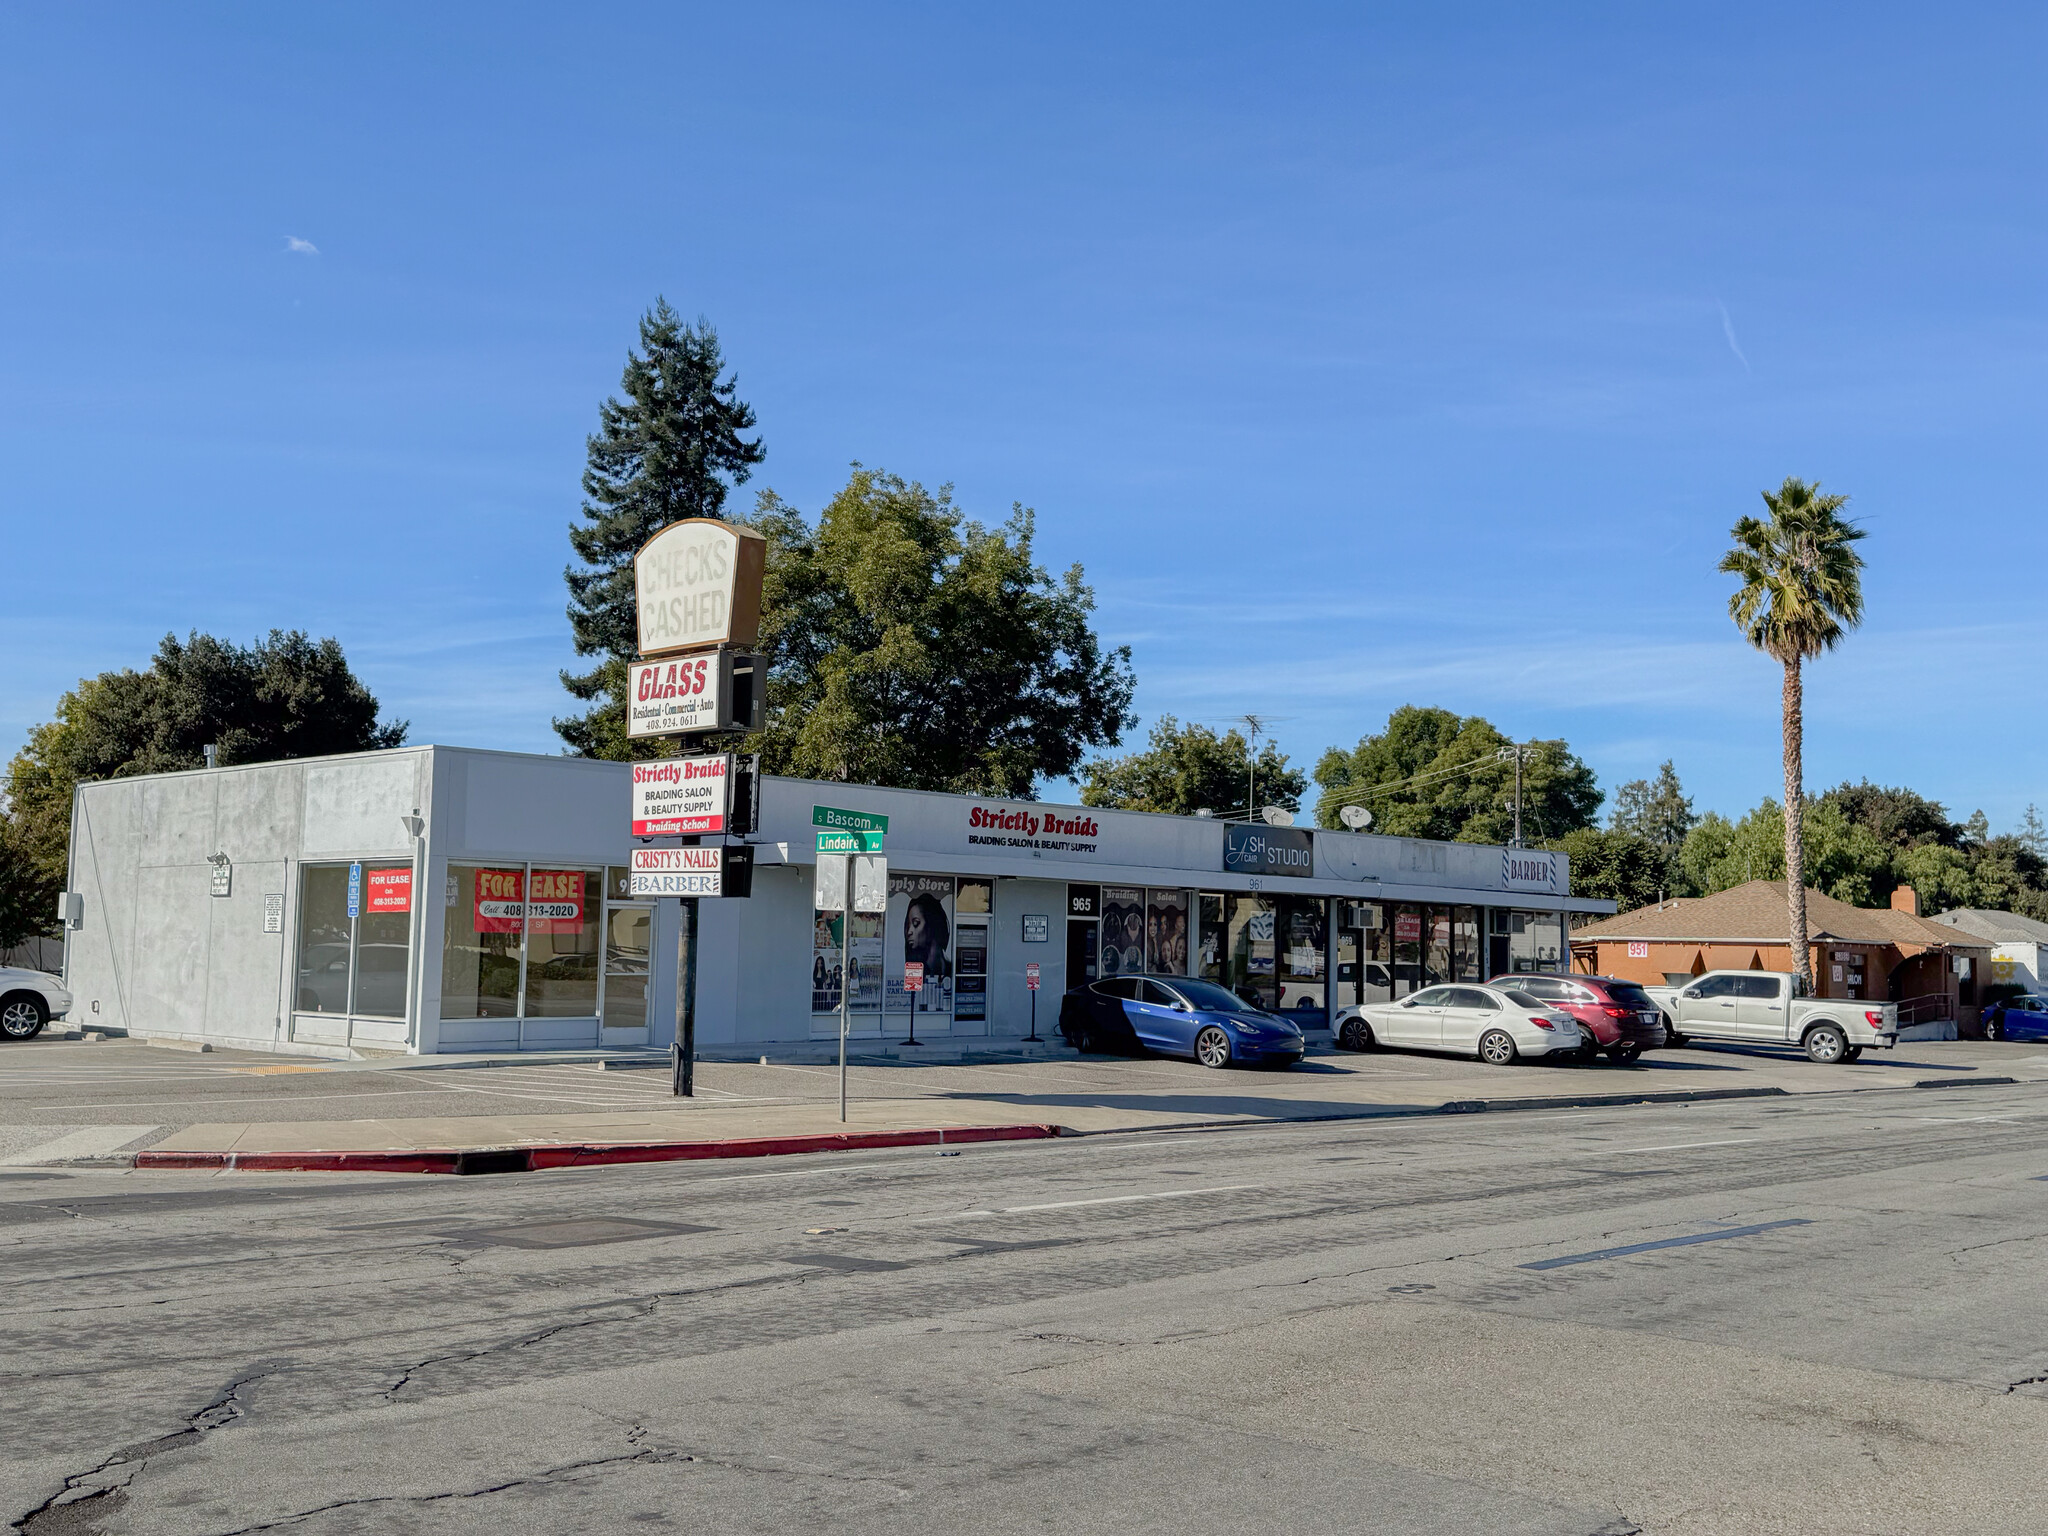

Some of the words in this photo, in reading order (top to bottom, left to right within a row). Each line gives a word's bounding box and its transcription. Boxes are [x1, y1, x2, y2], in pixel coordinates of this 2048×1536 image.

[644, 539, 727, 595] CHECKS
[643, 589, 726, 642] CASHED
[638, 660, 708, 702] GLASS
[633, 704, 661, 720] Residential
[665, 700, 696, 716] Commercial
[700, 699, 714, 711] Auto
[633, 763, 681, 784] Strictly
[684, 759, 726, 780] Braids
[645, 788, 683, 801] BRAIDING
[684, 786, 712, 798] SALON
[644, 806, 650, 815] &
[651, 803, 683, 815] BEAUTY
[683, 801, 713, 813] SUPPLY
[646, 819, 681, 833] Braiding
[682, 817, 710, 831] School
[826, 811, 871, 830] Bascom
[969, 806, 1039, 837] Strictly
[1043, 813, 1098, 837] Braids
[818, 836, 859, 850] Lindaire
[871, 841, 880, 849] Av
[968, 835, 1007, 847] BRAIDING
[1007, 837, 1033, 848] SALON
[1034, 840, 1040, 849] &
[1041, 840, 1070, 851] BEAUTY
[1070, 842, 1098, 853] SUPPLY
[635, 850, 681, 869] CRISTY'S
[683, 850, 718, 868] NAILS
[1267, 847, 1310, 867] STUDIO
[1510, 859, 1548, 882] BARBER
[371, 876, 386, 885] FOR
[386, 875, 410, 884] LEASE
[480, 873, 516, 897] FOR
[637, 876, 711, 892] BARBER
[887, 877, 916, 893] pply
[917, 877, 951, 892] Store
[1249, 879, 1263, 890] 961
[1106, 889, 1139, 902] Braiding
[1156, 892, 1177, 902] Salon
[1072, 897, 1091, 912] 965
[1629, 943, 1648, 957] 951
[887, 979, 905, 987] BLAC
